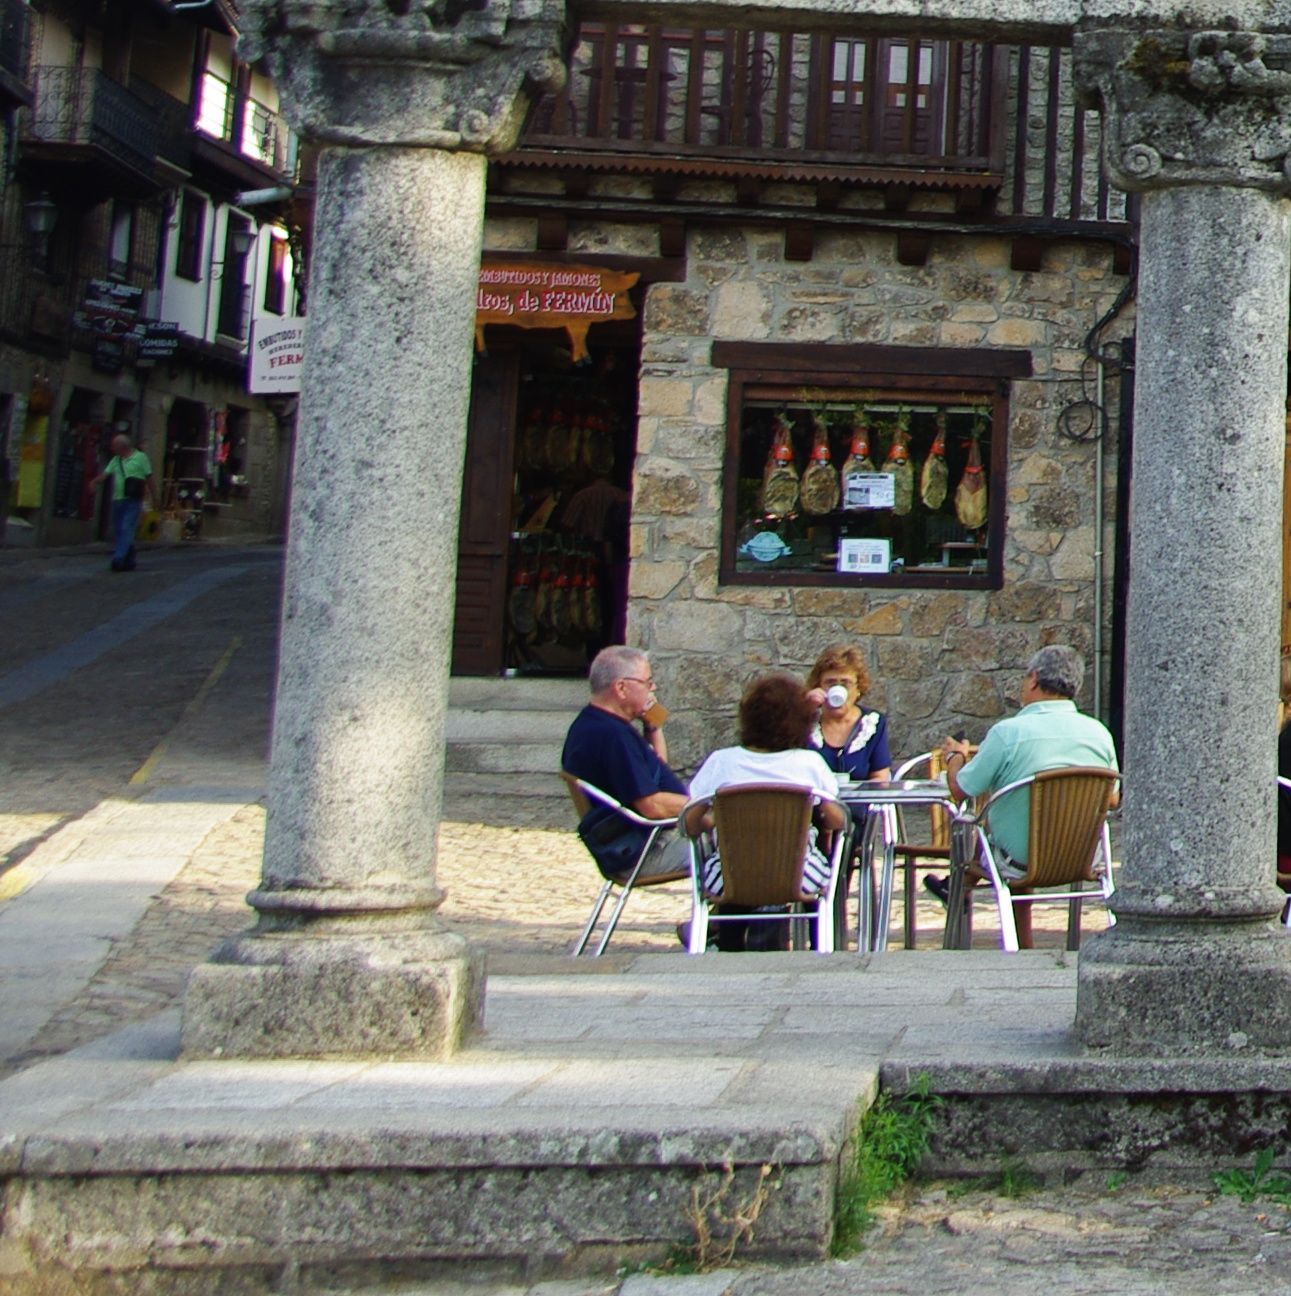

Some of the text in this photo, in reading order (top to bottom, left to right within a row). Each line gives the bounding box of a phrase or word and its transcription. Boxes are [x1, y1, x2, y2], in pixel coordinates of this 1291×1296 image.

[519, 290, 540, 312] de
[258, 329, 297, 351] EMBUTIDOS
[269, 354, 303, 368] FERM
